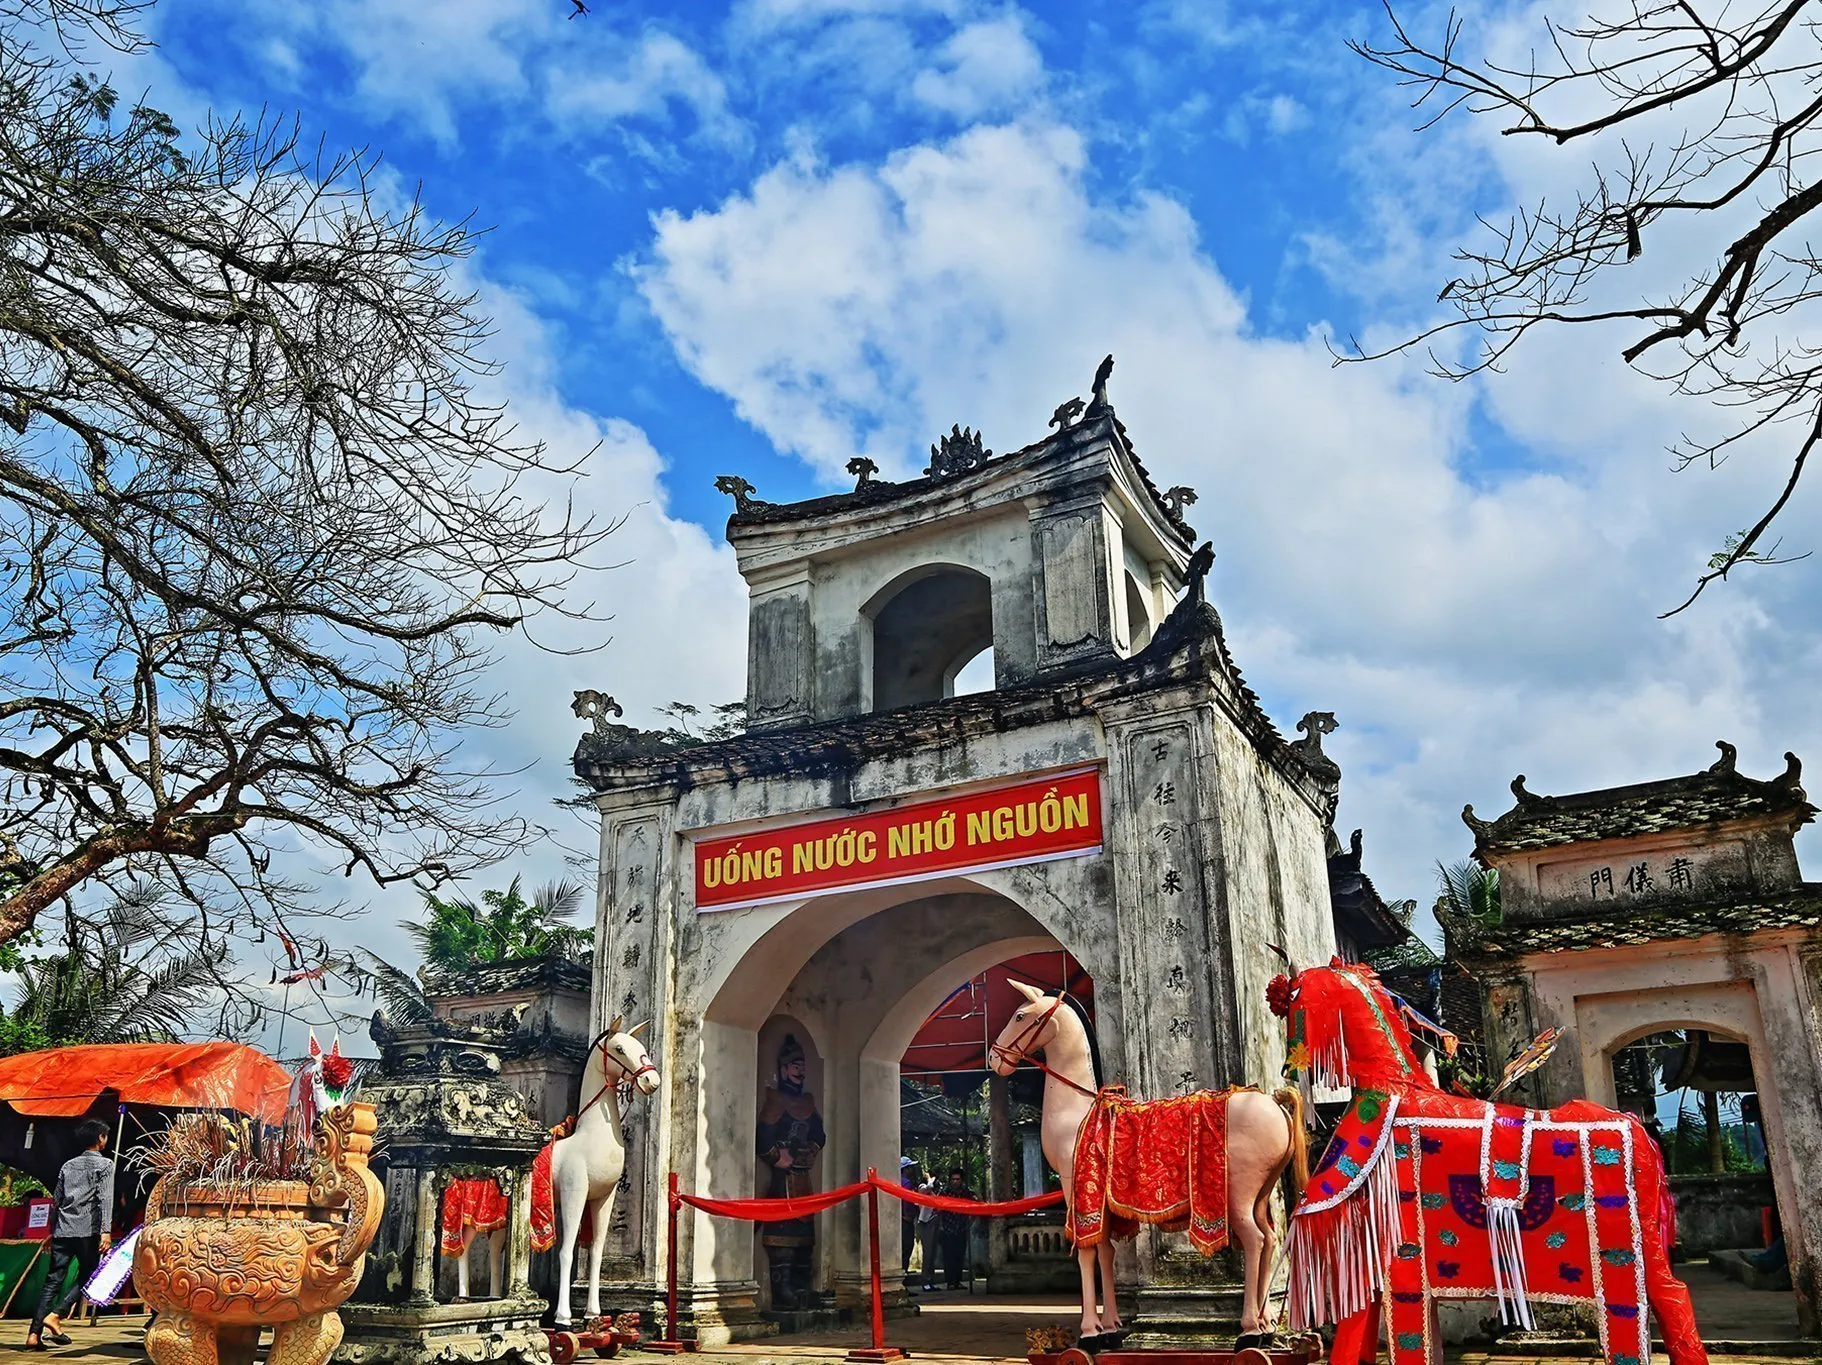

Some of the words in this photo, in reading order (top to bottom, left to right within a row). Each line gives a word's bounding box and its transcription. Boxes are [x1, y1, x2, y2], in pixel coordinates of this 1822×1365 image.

[703, 842, 783, 889] UỐNG
[792, 827, 877, 875] NƯỚC
[887, 809, 956, 859] NHỚ
[966, 786, 1090, 846] NGUỒN
